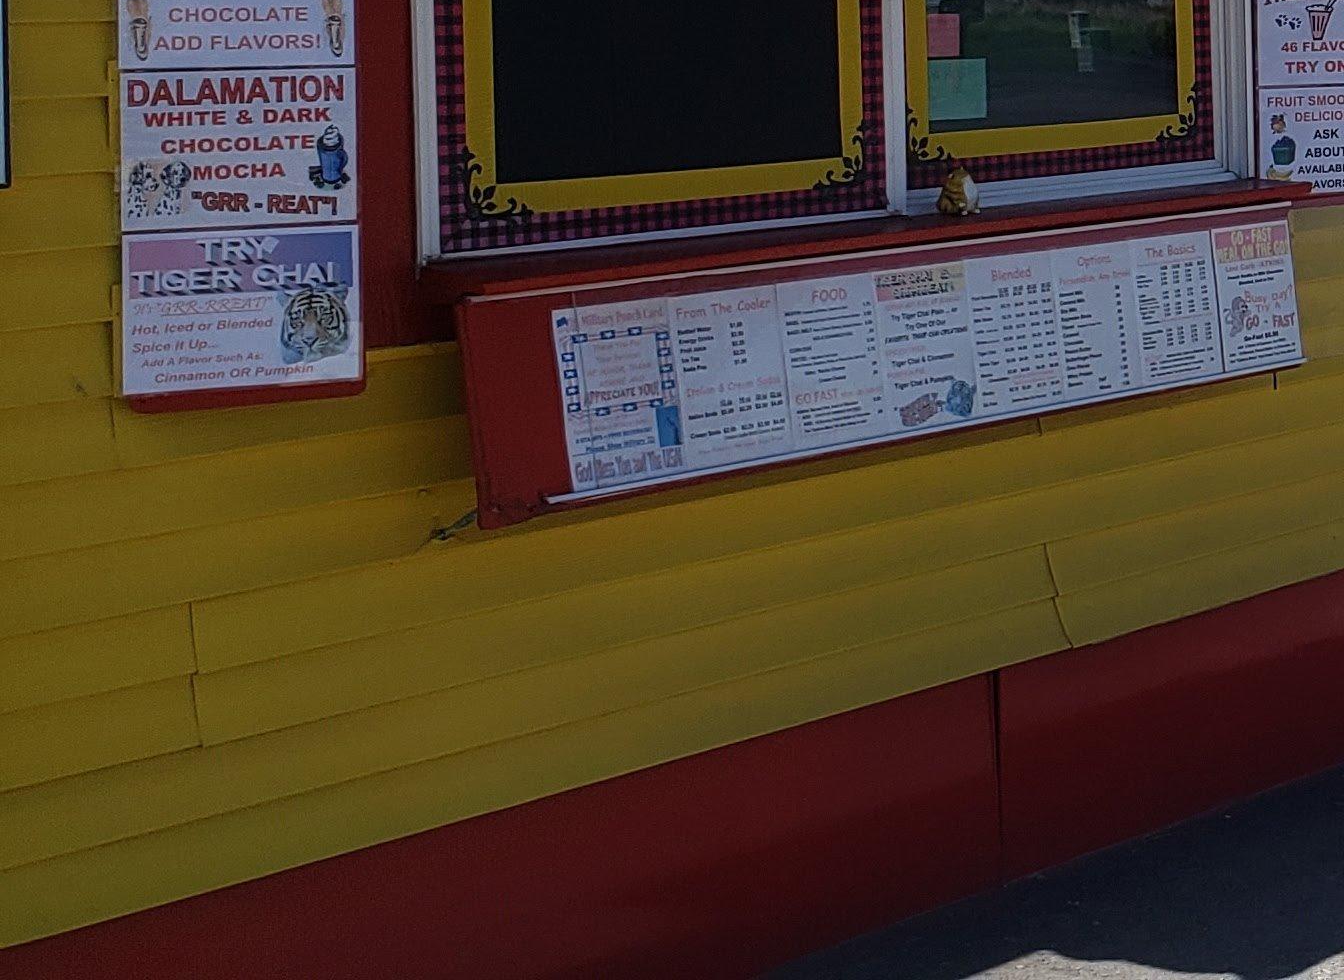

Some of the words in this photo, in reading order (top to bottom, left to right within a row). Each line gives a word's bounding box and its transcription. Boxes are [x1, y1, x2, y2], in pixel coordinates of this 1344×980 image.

[168, 7, 308, 22] CHOCOLATE
[154, 35, 202, 50] ADD
[210, 34, 321, 50] FLAVORS!
[1281, 41, 1298, 53] 46
[1285, 61, 1318, 73] TRY
[127, 74, 345, 107] DALAMATION
[1267, 95, 1304, 108] FRUIT
[143, 110, 227, 127] WHITE
[235, 109, 253, 124] &
[263, 107, 332, 124] DARK
[1313, 128, 1339, 140] ASK
[160, 134, 315, 154] CHOCOLATE
[193, 162, 286, 181] MOCHA
[1251, 226, 1272, 243] FAST
[196, 236, 280, 265] TRY
[1145, 247, 1164, 259] The
[1167, 244, 1197, 257] Basics
[131, 268, 242, 296] TIGER
[252, 262, 336, 290] CHAI
[811, 287, 848, 302] FOOD
[676, 308, 709, 320] From
[710, 302, 734, 315] The
[737, 297, 771, 311] Cooler
[131, 323, 160, 336] Hot,
[164, 321, 195, 333] Iced
[198, 322, 212, 332] or
[216, 316, 274, 331] Blended
[1273, 312, 1295, 327] FAST
[132, 342, 171, 355] Spice
[141, 356, 164, 368] Add
[178, 353, 211, 365] Flavor
[214, 352, 243, 362] Such
[155, 367, 225, 383] Cinnamon
[229, 365, 250, 378] OR
[254, 363, 314, 378] Pumpkin
